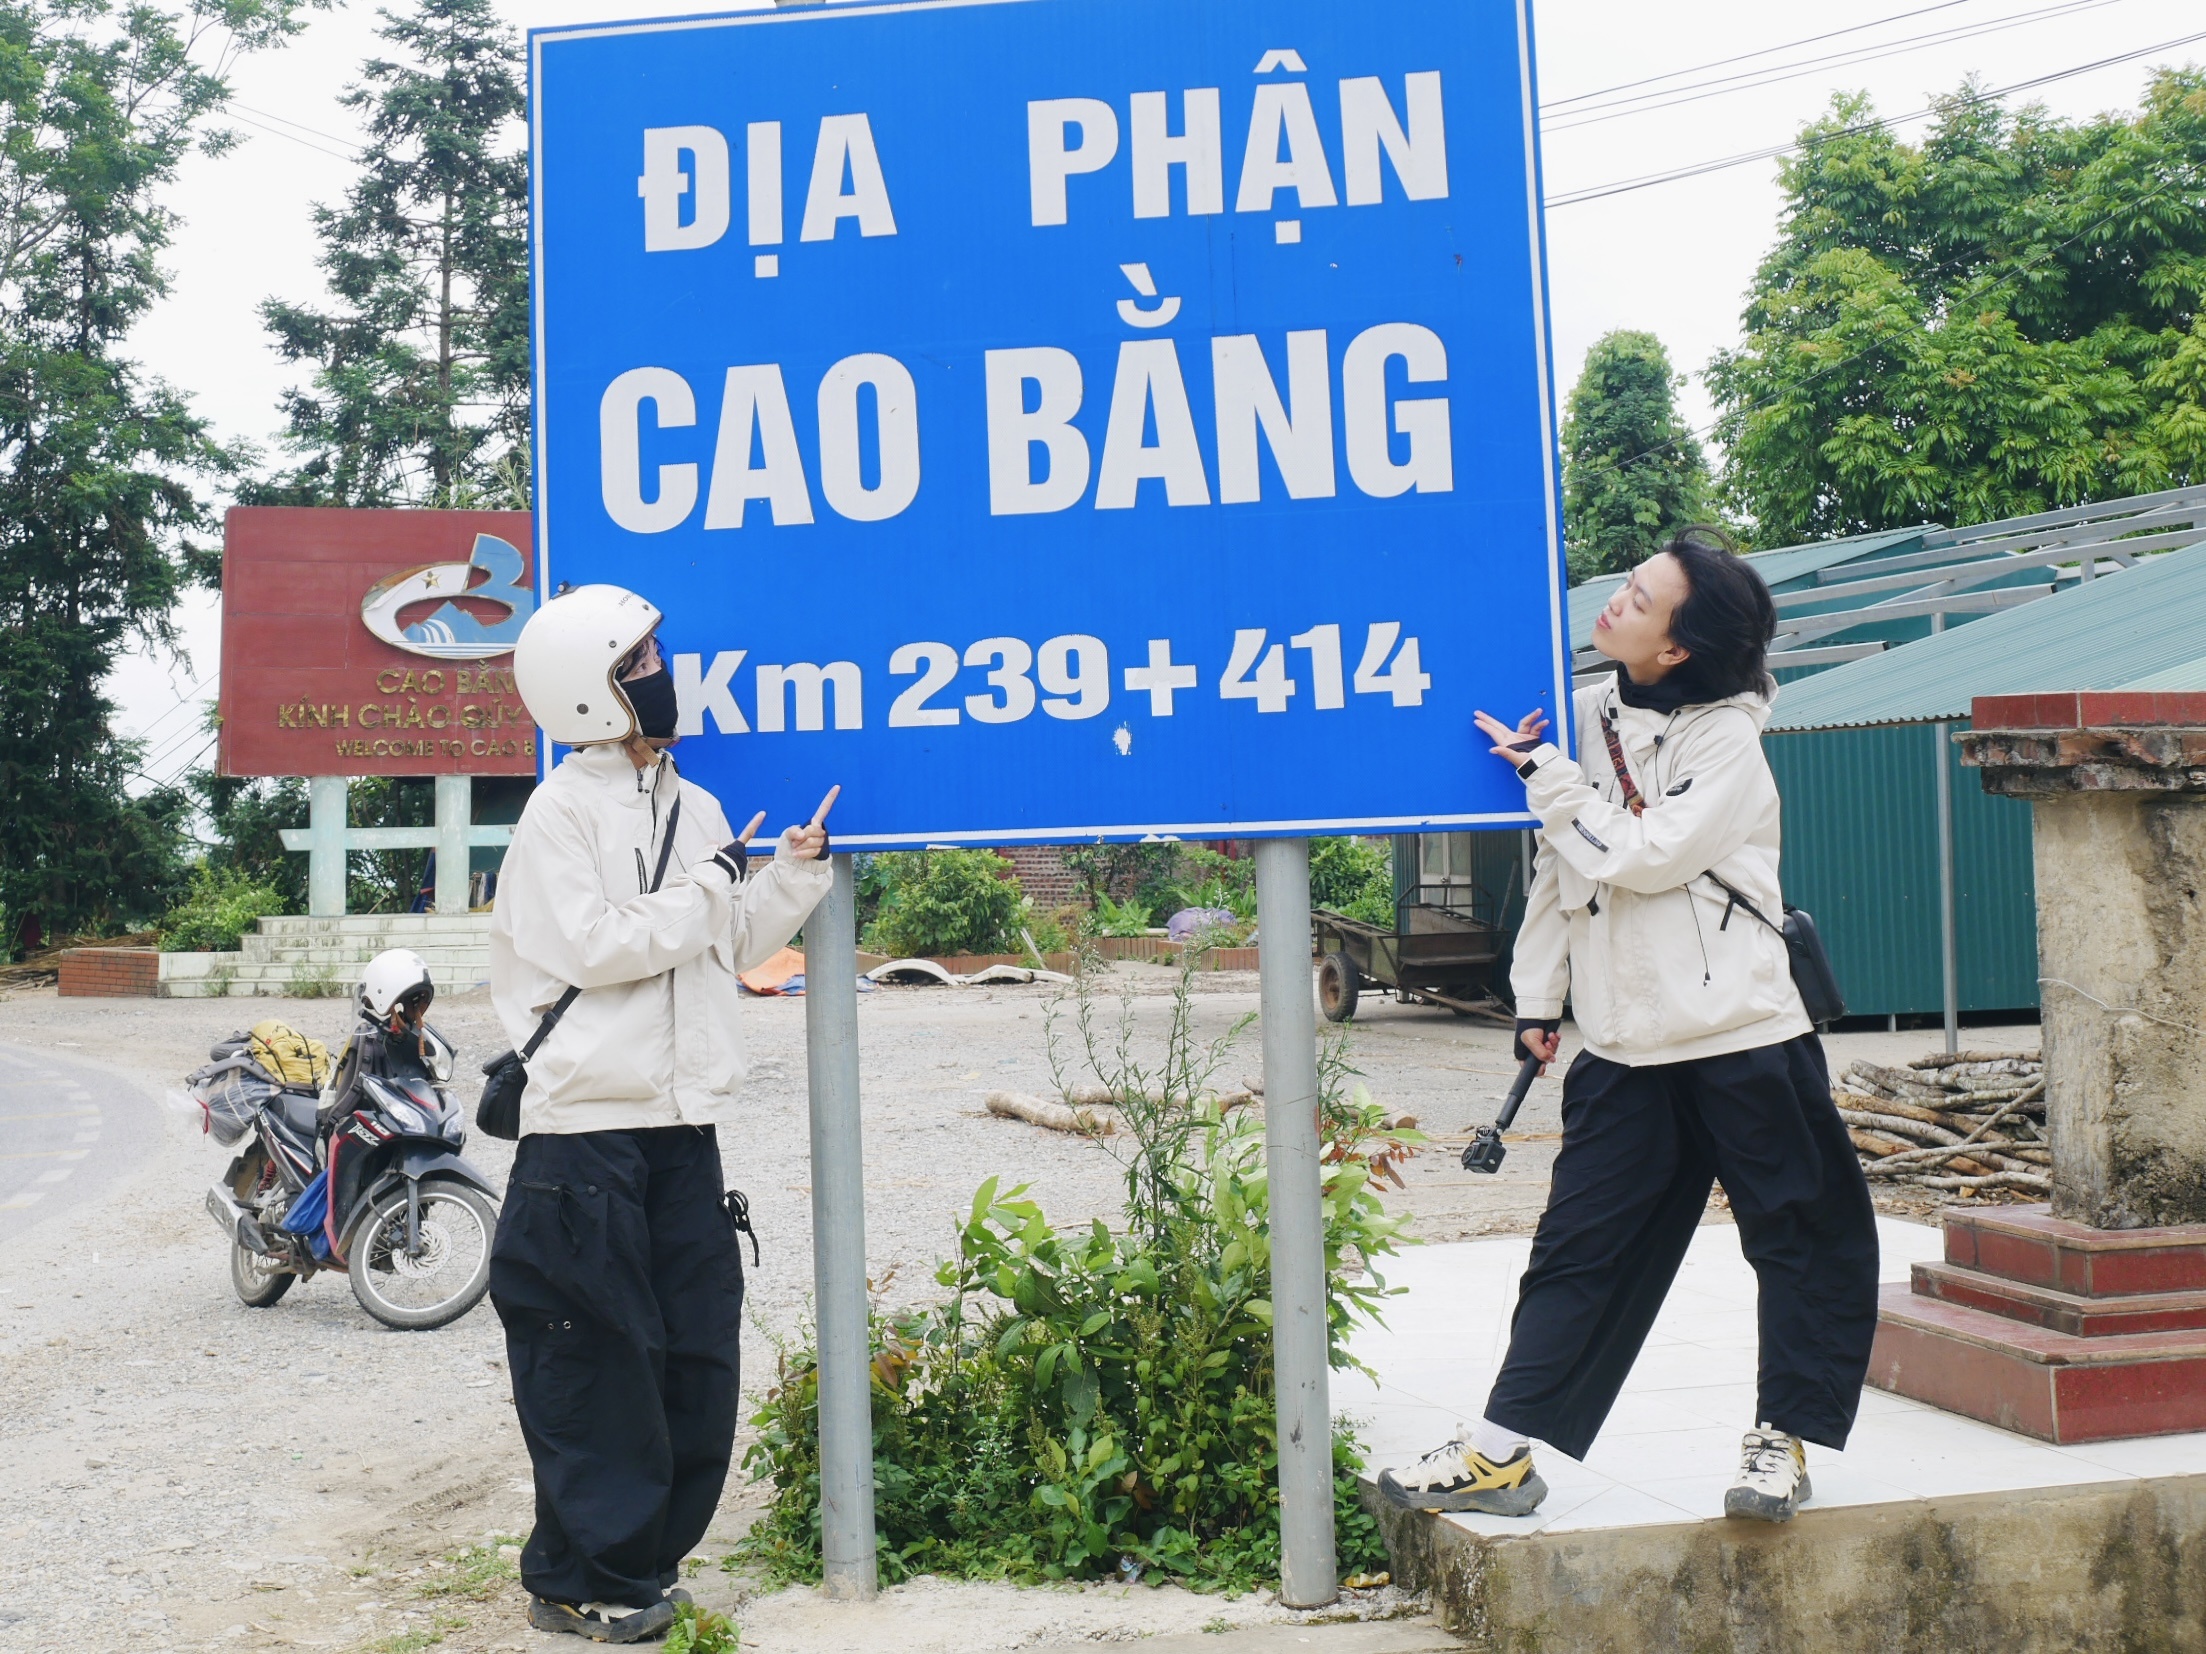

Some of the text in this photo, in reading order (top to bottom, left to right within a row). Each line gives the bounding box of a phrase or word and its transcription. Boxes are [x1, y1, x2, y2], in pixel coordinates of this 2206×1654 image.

[637, 49, 1449, 278] ĐỊA PHẬN
[599, 262, 1454, 534] CAO BẰNG
[278, 694, 349, 728] KÍNH
[358, 696, 451, 728] CHÀO
[376, 659, 515, 694] CAO BẰN
[672, 649, 863, 739] Km
[888, 633, 1110, 728] 239
[1219, 621, 1431, 713] 414
[335, 739, 434, 757] WELCOME
[440, 739, 466, 757] TO
[470, 739, 517, 757] CAO
